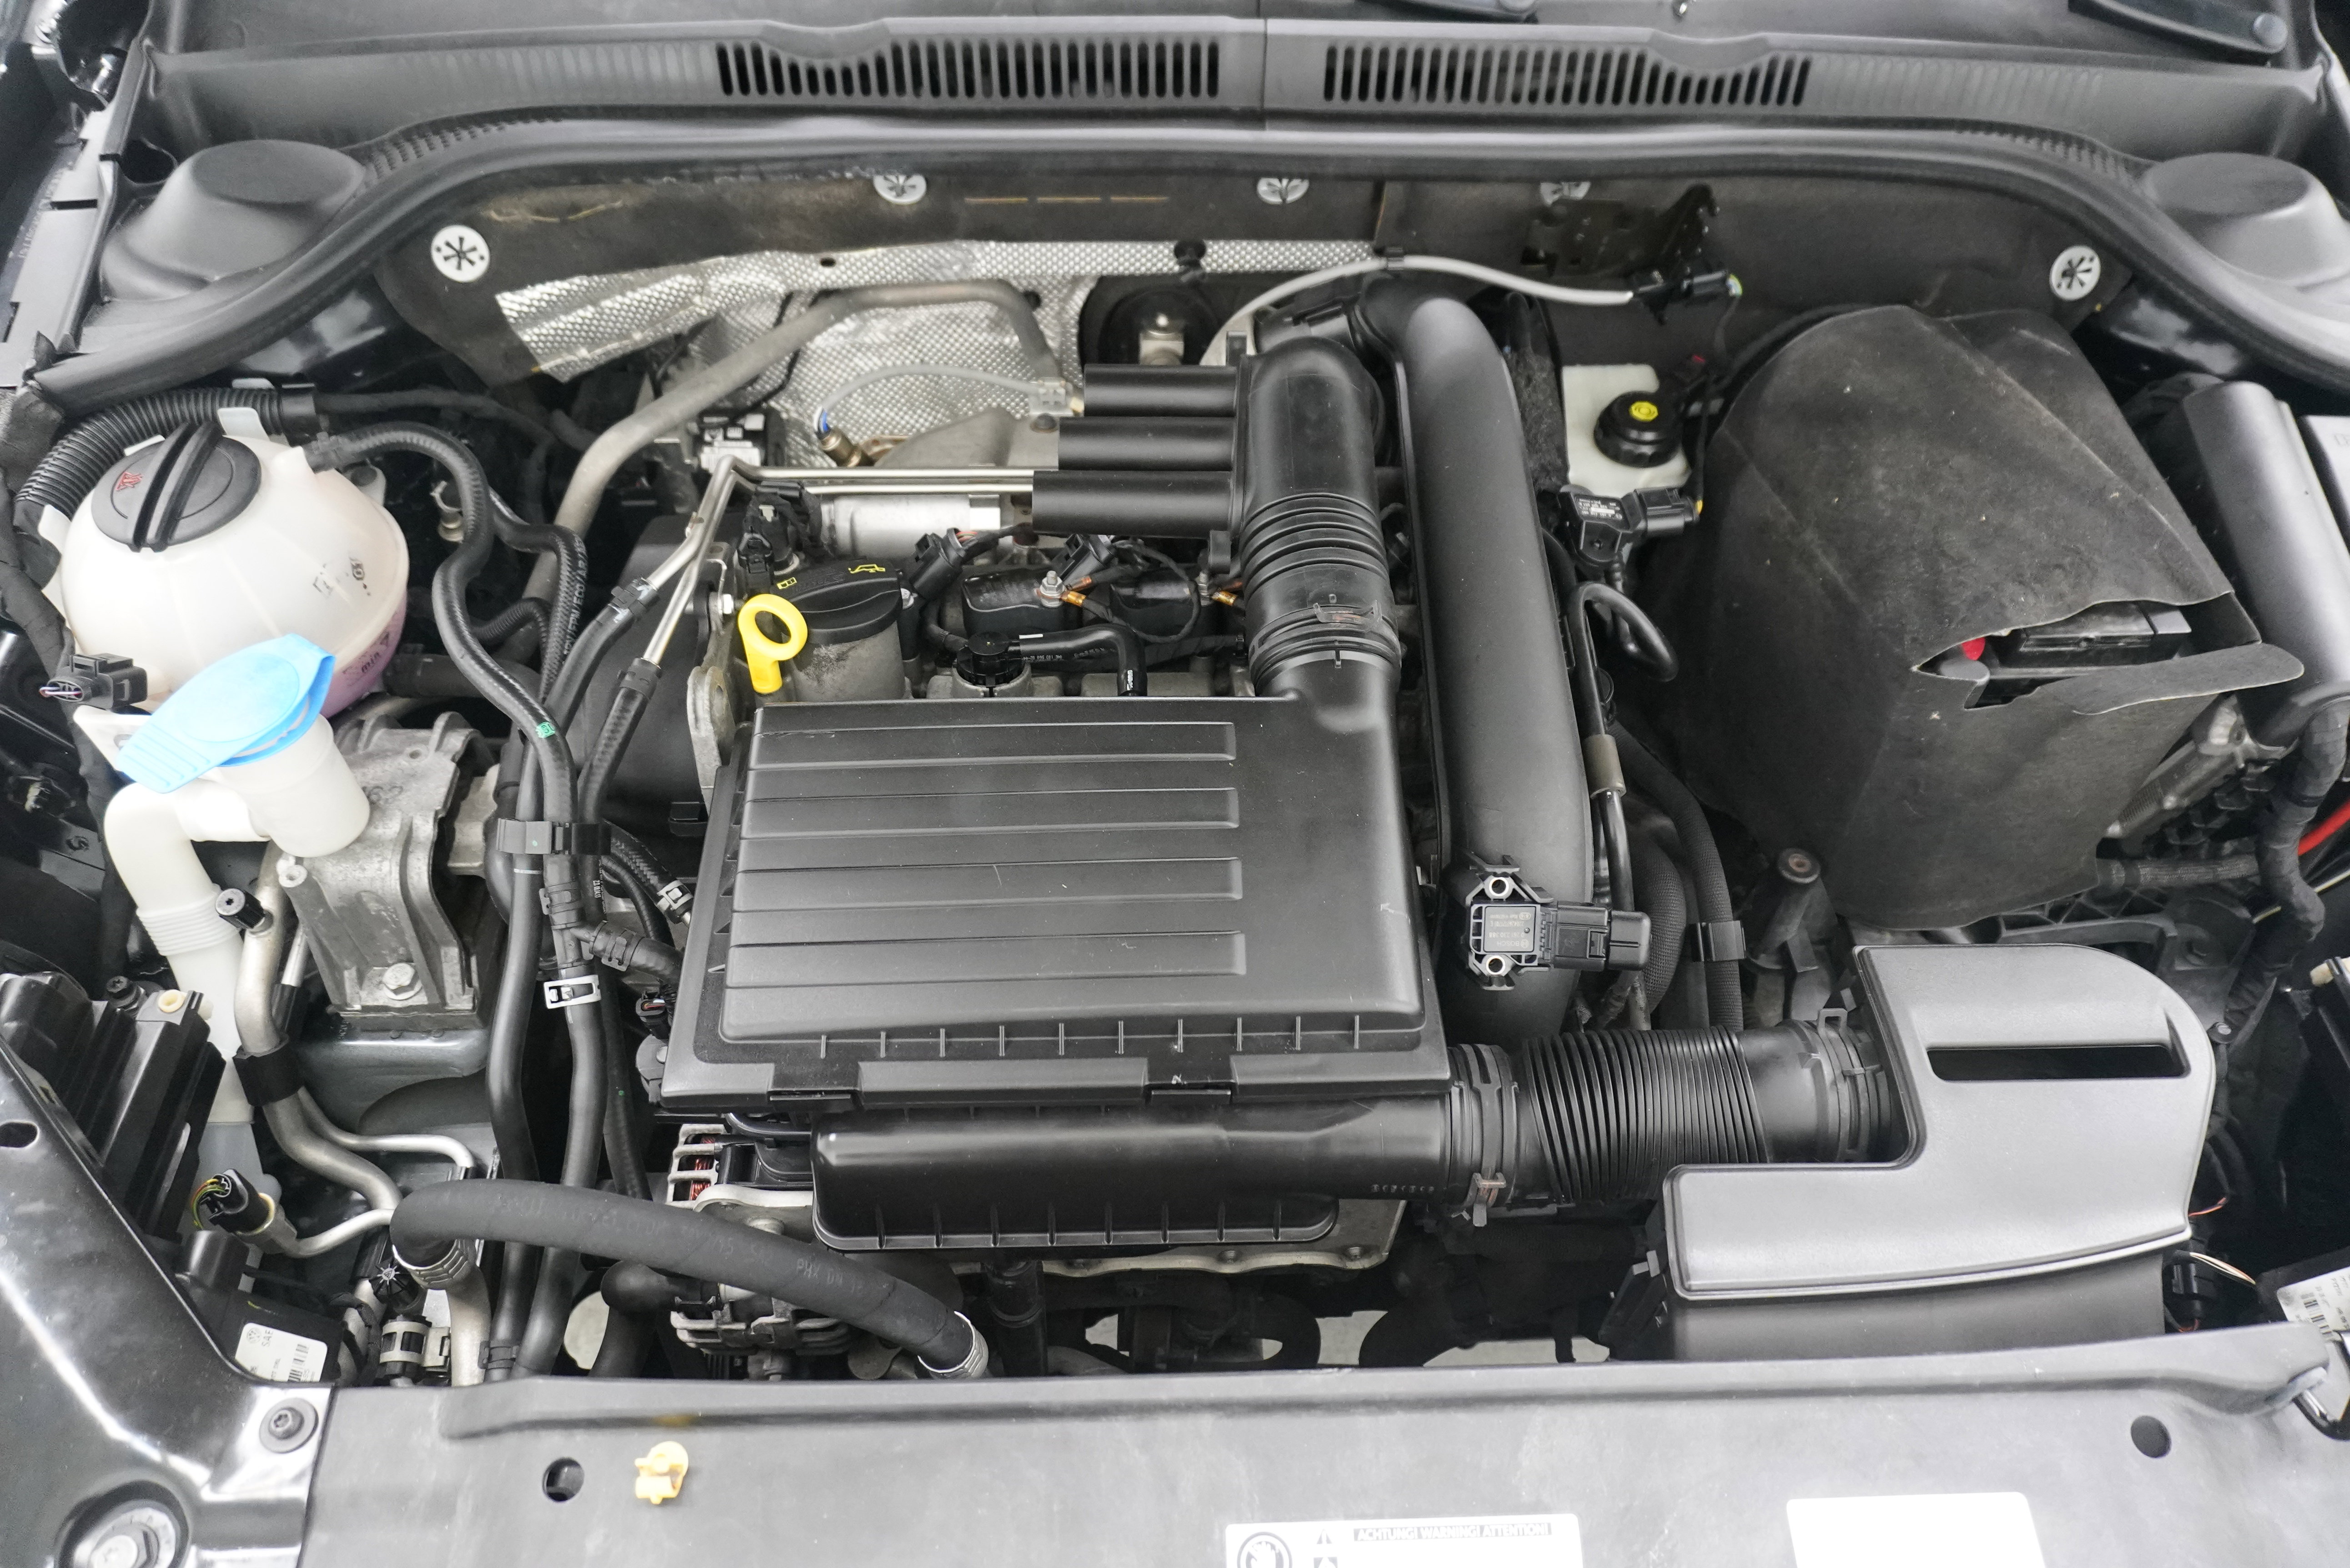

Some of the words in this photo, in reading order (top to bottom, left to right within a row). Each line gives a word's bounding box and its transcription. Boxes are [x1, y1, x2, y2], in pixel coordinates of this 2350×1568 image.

[262, 1330, 273, 1347] SAE
[1357, 1528, 1418, 1541] ACHTUNG!
[1420, 1526, 1481, 1539] WARNING!
[1482, 1523, 1549, 1538] ATTENTION!
